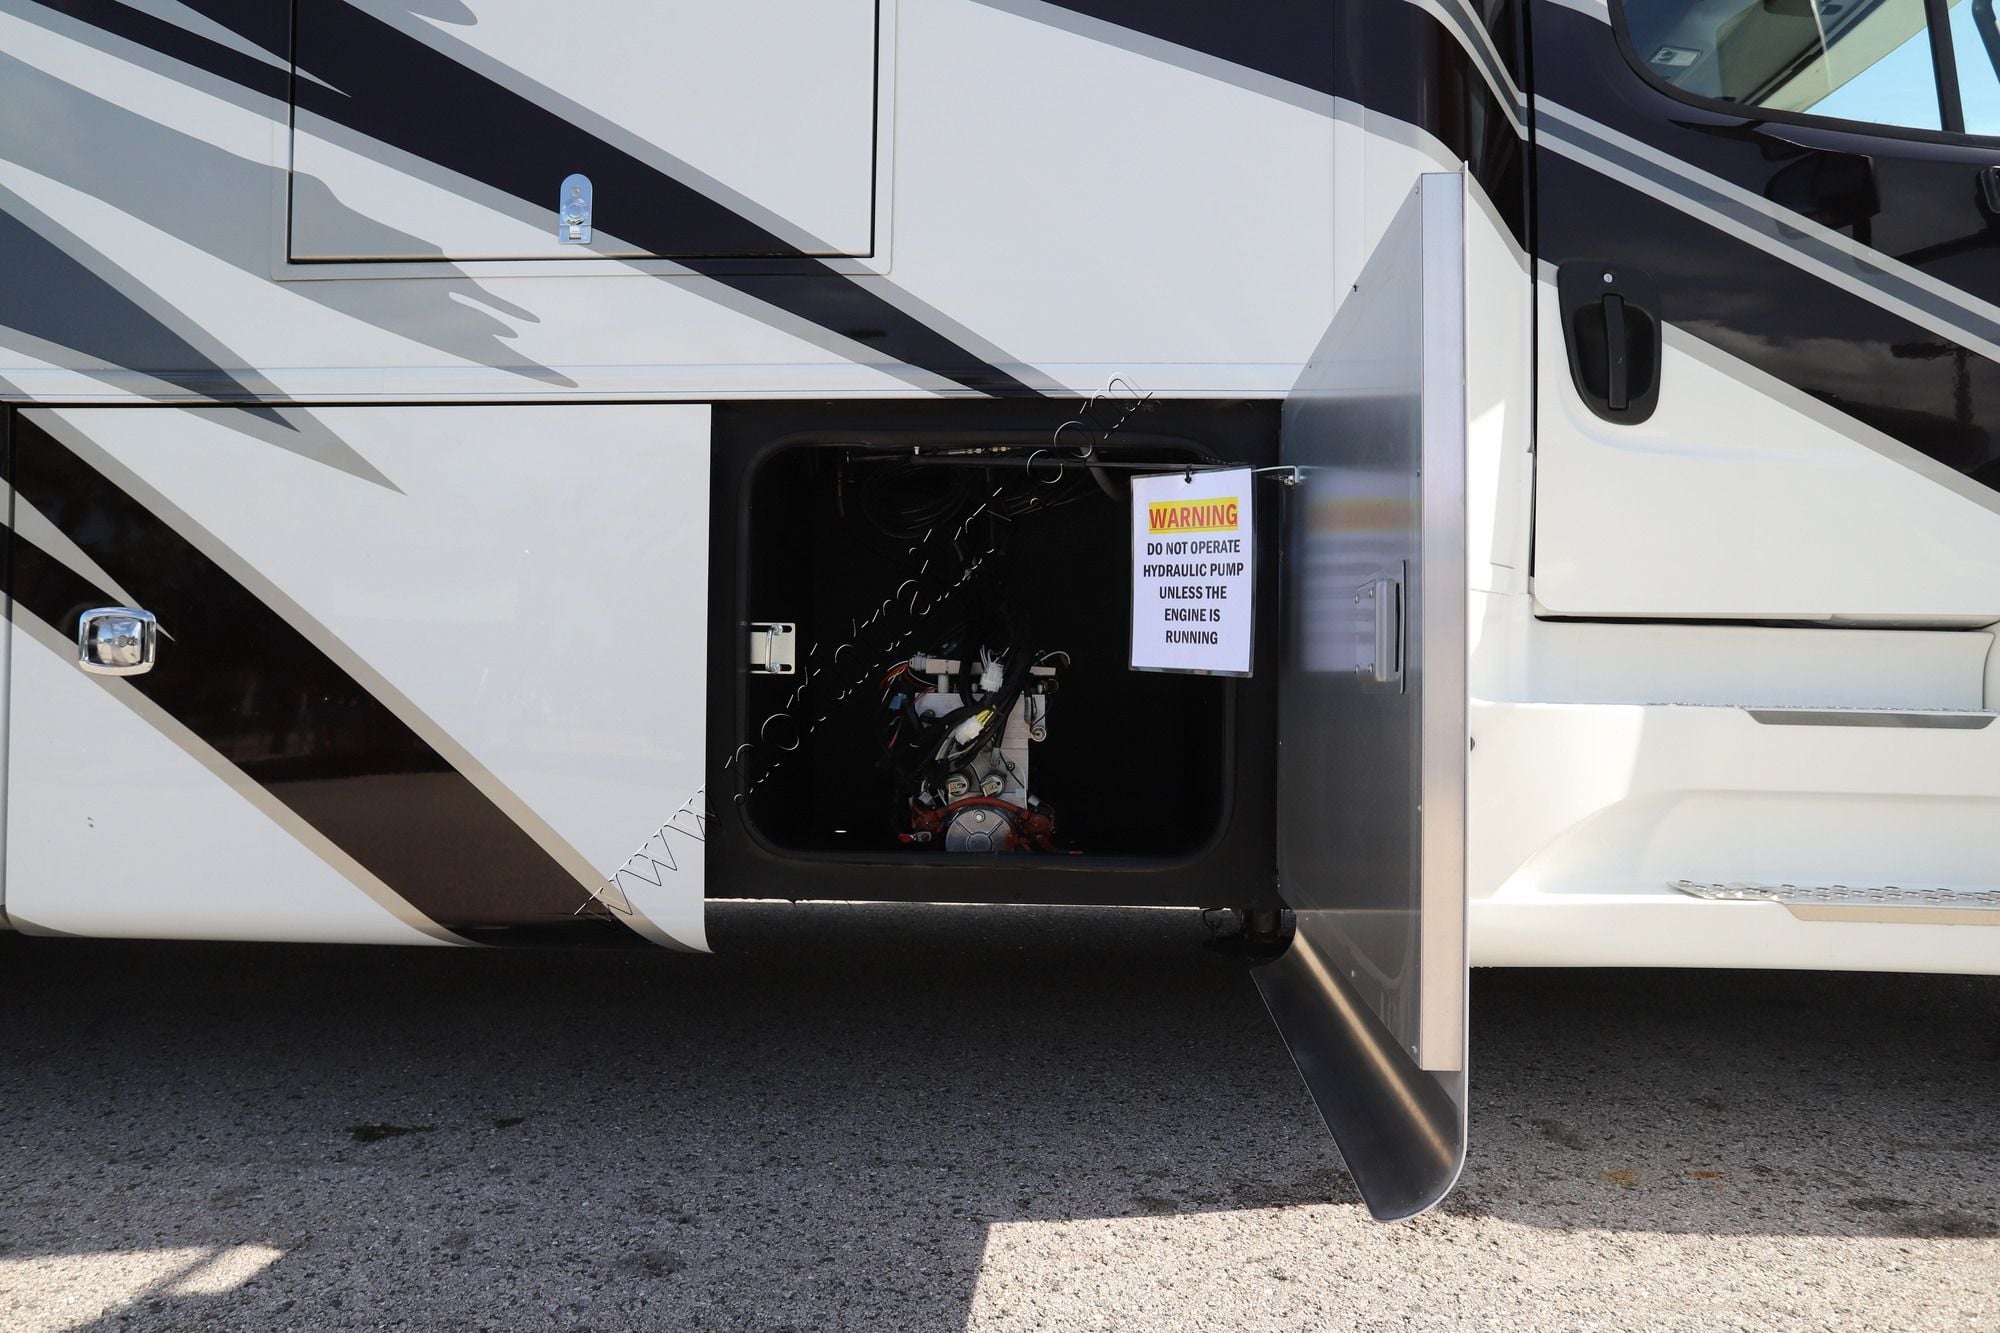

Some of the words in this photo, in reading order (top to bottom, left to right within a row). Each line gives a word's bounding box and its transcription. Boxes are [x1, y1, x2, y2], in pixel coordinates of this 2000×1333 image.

[1149, 503, 1238, 529] WARNING
[1147, 542, 1163, 555] DO
[1166, 541, 1187, 554] NOT
[1191, 539, 1241, 553] OPERATE
[1143, 563, 1207, 576] HYDRAULIC
[1210, 562, 1244, 576] PUMP
[1159, 586, 1203, 599] UNLESS
[1206, 586, 1227, 599] THE
[1164, 608, 1206, 621] ENGINE
[1209, 608, 1221, 621] IS
[1166, 630, 1218, 644] RUNNING
